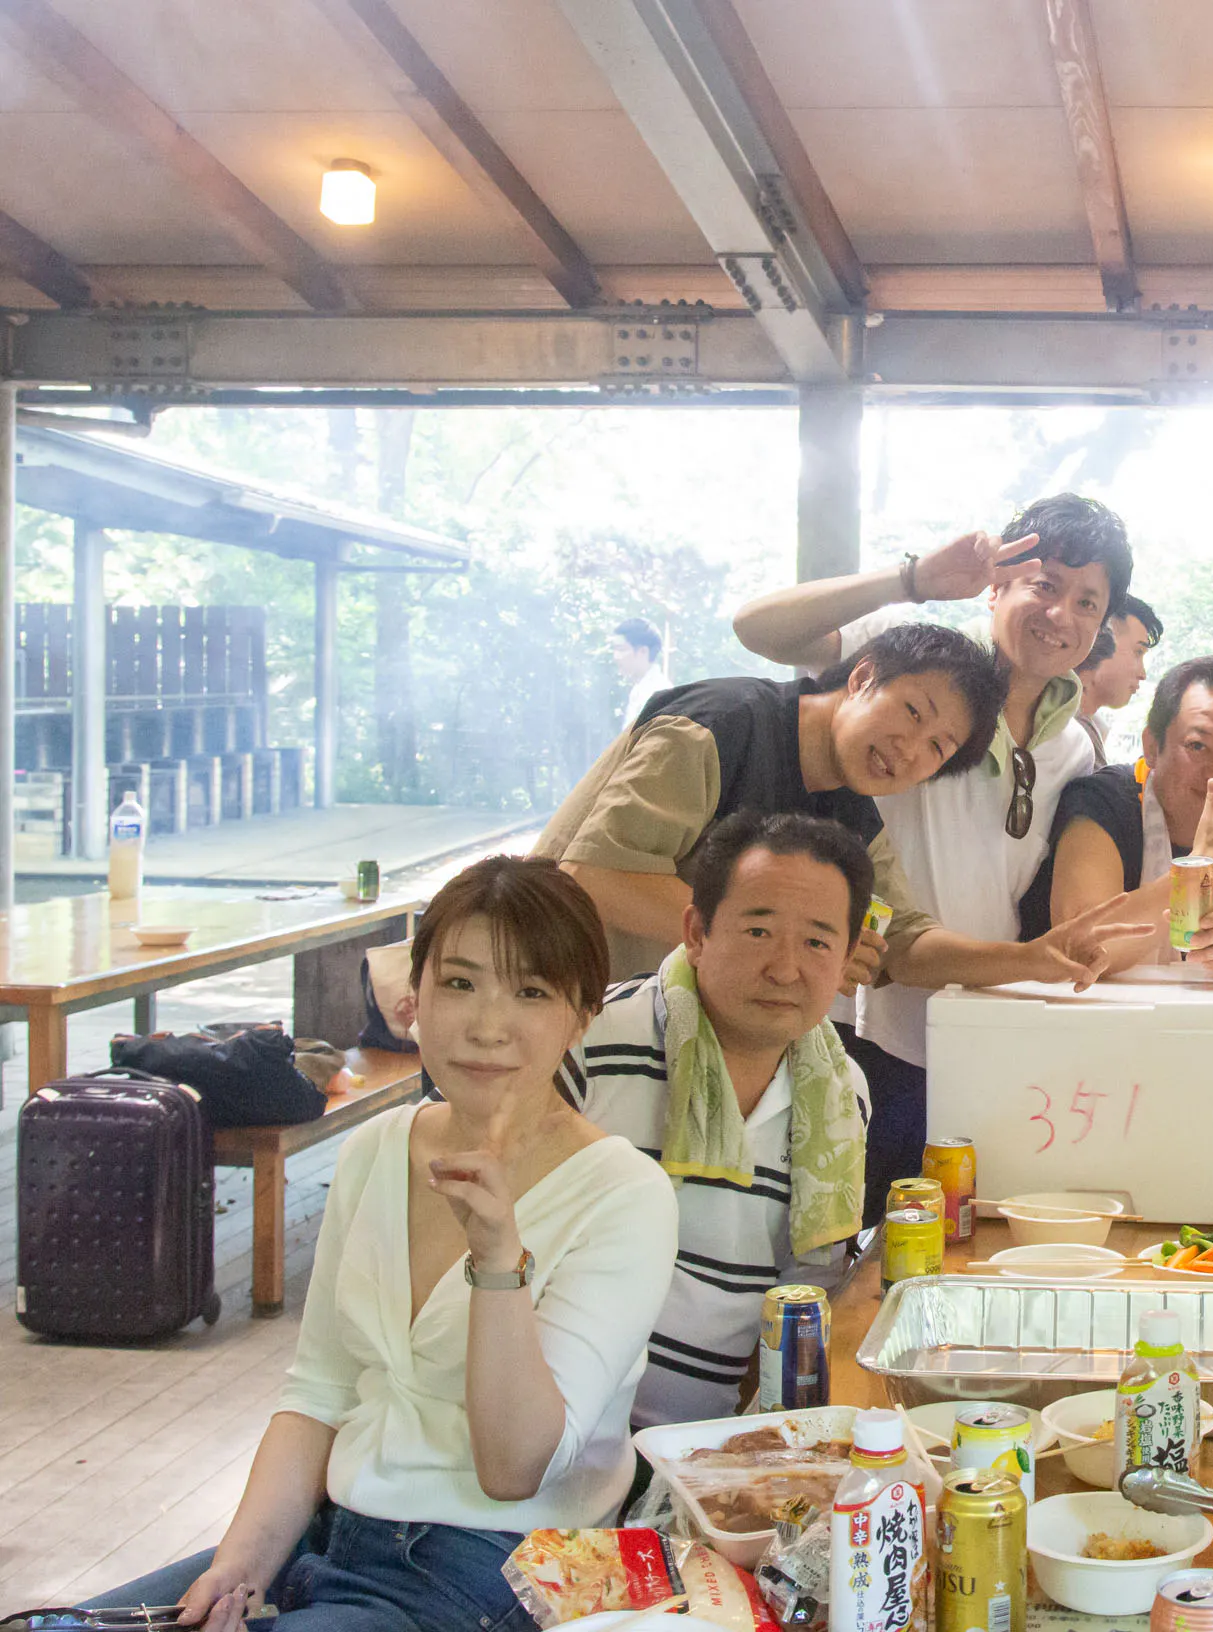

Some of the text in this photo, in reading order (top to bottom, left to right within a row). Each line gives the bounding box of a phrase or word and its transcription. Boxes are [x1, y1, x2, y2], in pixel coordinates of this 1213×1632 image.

[1027, 1081, 1142, 1154] 351
[1158, 1401, 1171, 1439] たっぷり
[1171, 1390, 1184, 1439] 香味野菜
[1151, 1437, 1189, 1473] 塩
[852, 1512, 868, 1546] 中辛
[704, 1571, 723, 1607] MIXED
[876, 1509, 910, 1631] 焼肉屋さん
